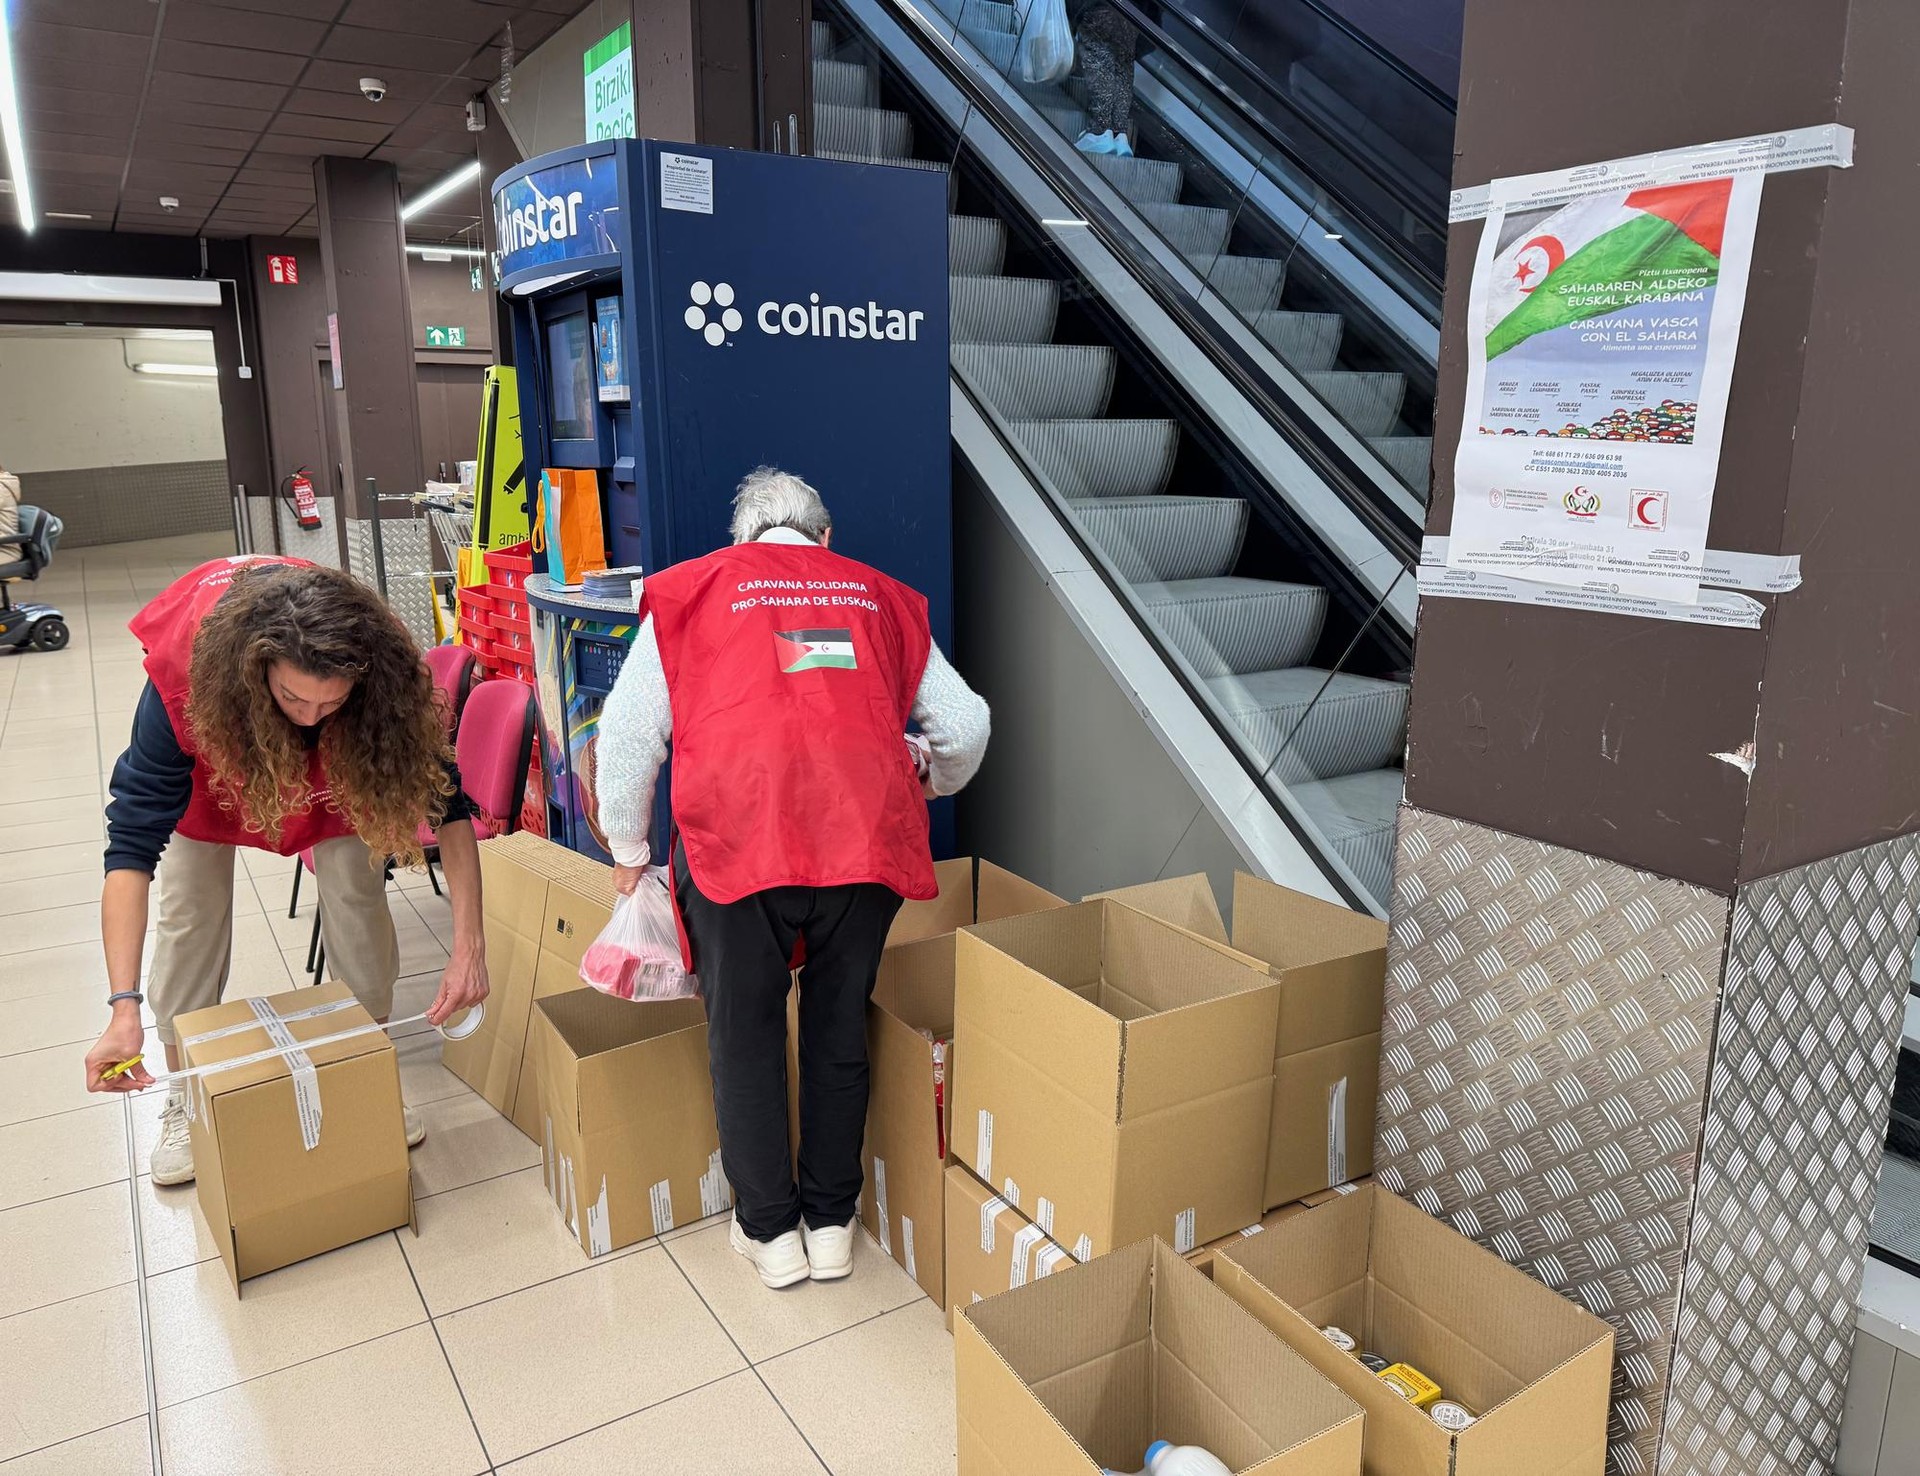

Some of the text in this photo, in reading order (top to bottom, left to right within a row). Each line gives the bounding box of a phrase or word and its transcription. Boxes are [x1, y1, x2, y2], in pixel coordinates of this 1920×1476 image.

[595, 59, 631, 113] Birzikl
[1559, 277, 1707, 295] SAHARAREN ALDEKO
[1568, 292, 1704, 306] EUSKAL KARABANA
[757, 292, 924, 341] coinstar
[1569, 317, 1699, 330] CARAVANA VASCA
[1580, 331, 1697, 342] CON EL SAHARA
[1601, 344, 1636, 352] Alimenta
[1655, 344, 1697, 352] esperanza
[737, 579, 868, 593] CARAVANA SOLIDARIA
[731, 595, 879, 613] PRO-SAHARA DE EUSKADI
